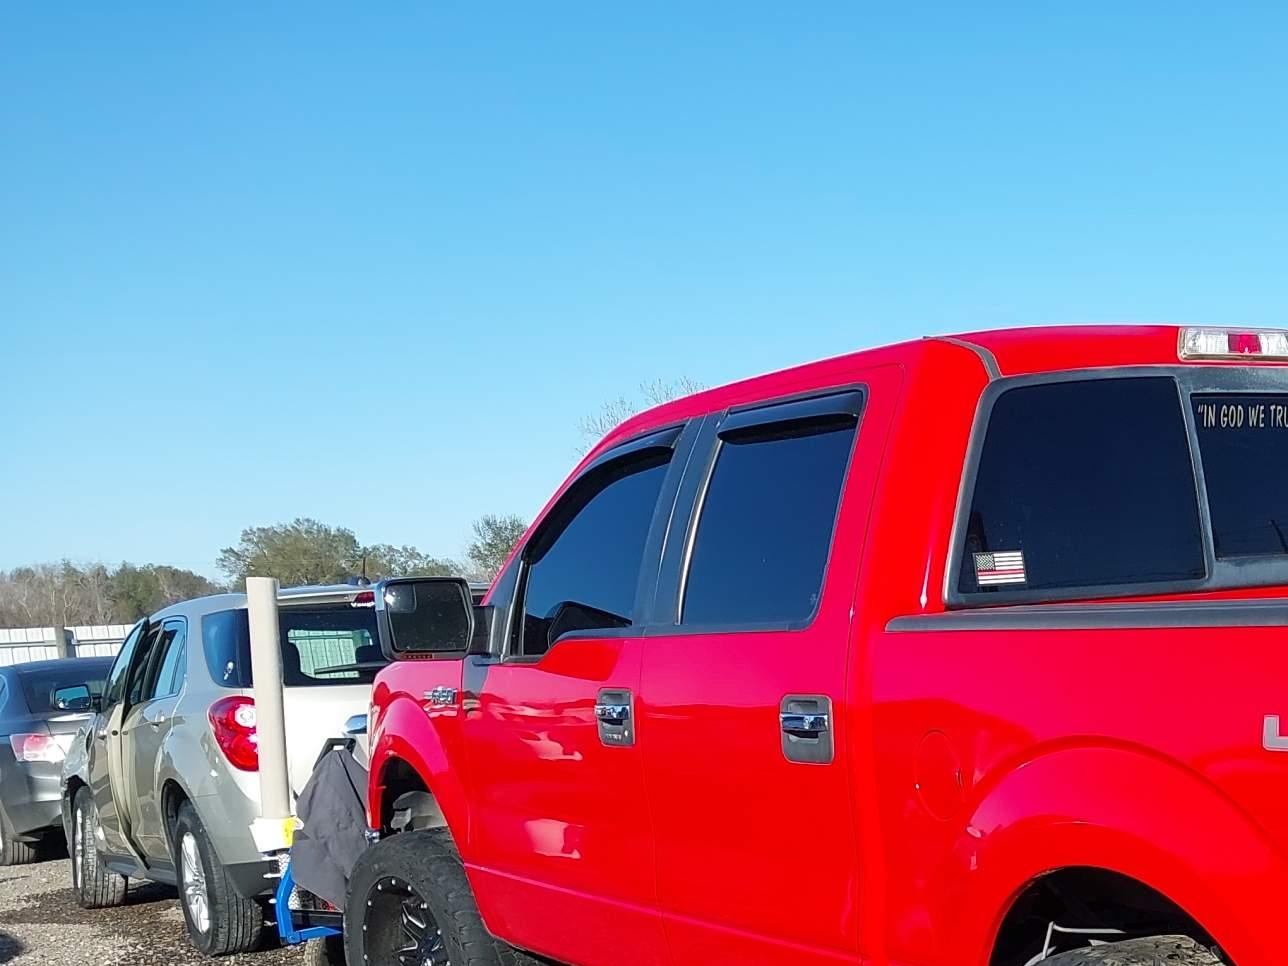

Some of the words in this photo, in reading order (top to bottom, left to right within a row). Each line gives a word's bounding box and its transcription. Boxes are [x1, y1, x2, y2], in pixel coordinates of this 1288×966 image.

[1197, 404, 1216, 427] "IN
[1220, 405, 1244, 428] GOD
[1248, 404, 1265, 428] WE
